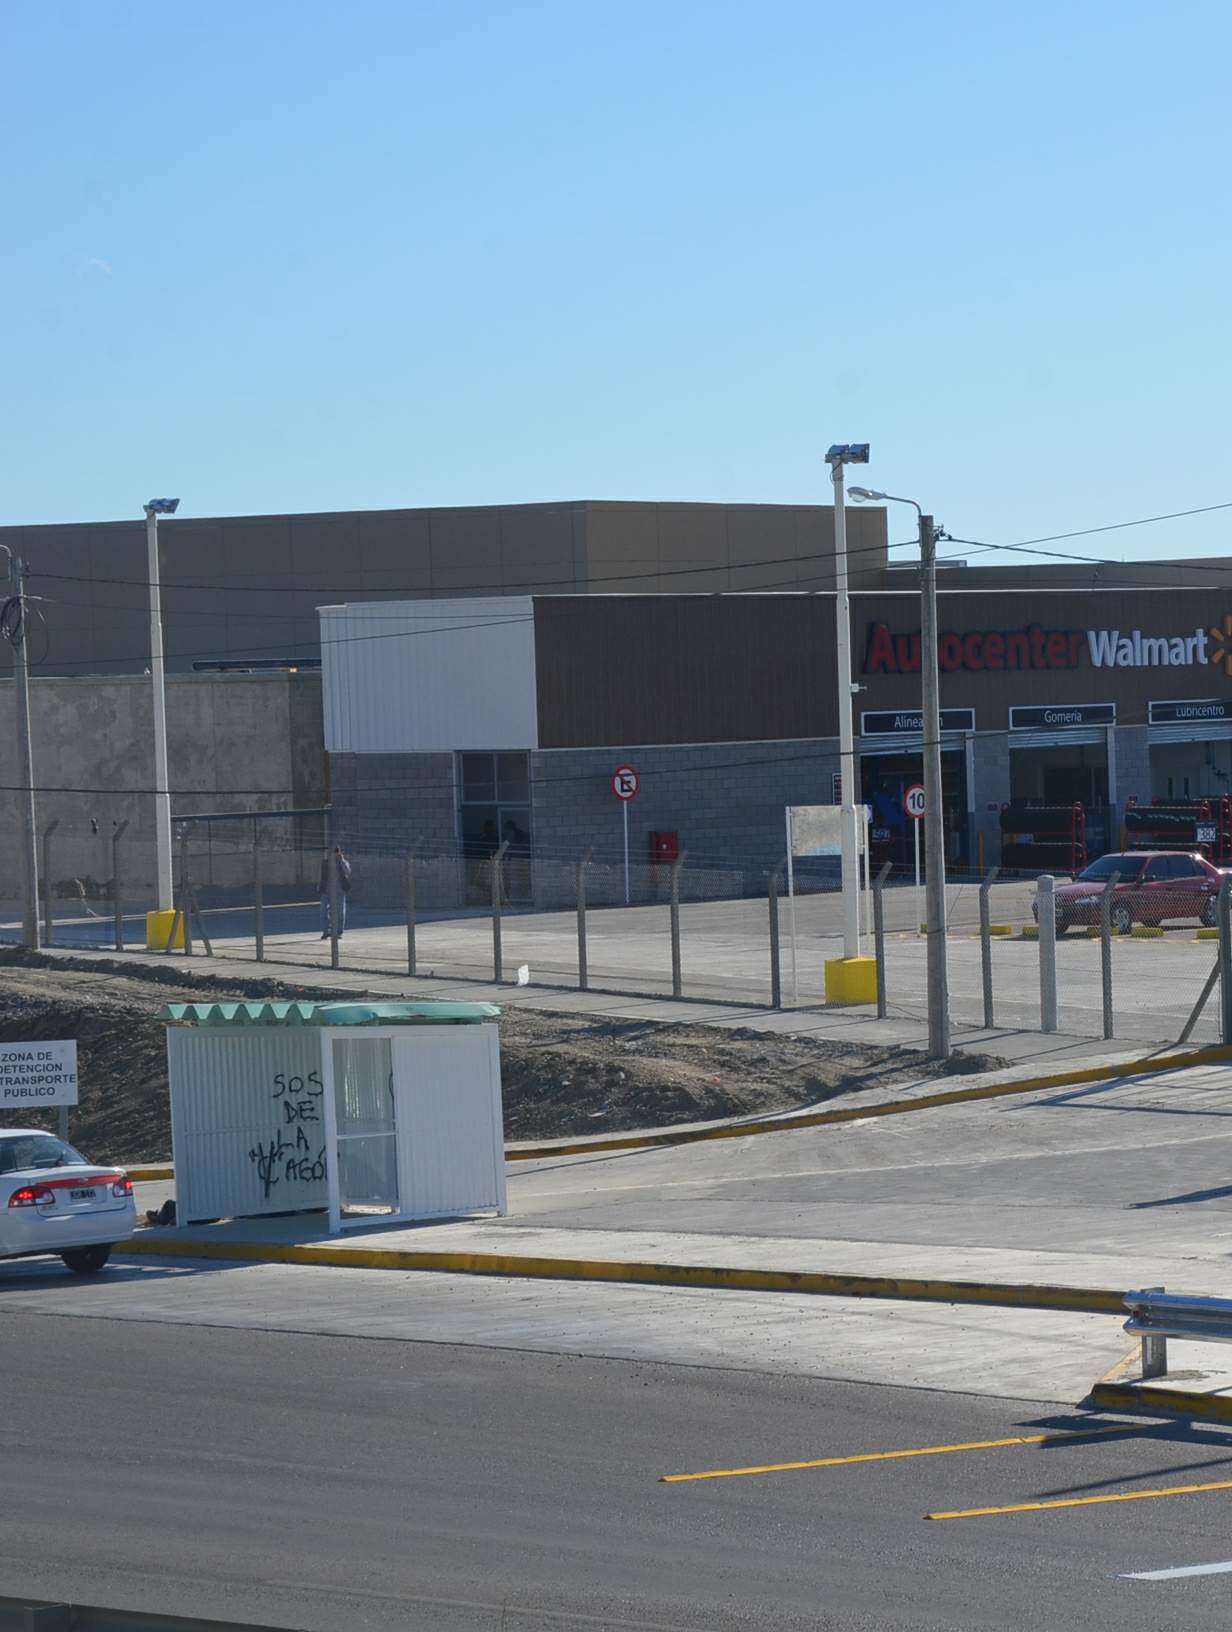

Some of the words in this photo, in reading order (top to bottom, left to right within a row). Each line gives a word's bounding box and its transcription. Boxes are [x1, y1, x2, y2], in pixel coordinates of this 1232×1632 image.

[863, 623, 1084, 672] Auocenter
[1088, 629, 1208, 667] Walmart
[621, 772, 634, 792] E
[909, 793, 925, 809] 10
[1, 1052, 34, 1062] ZONA
[37, 1051, 53, 1060] DE
[4, 1086, 56, 1098] PUBLICO
[272, 1071, 324, 1098] SOS
[283, 1100, 319, 1124] DE
